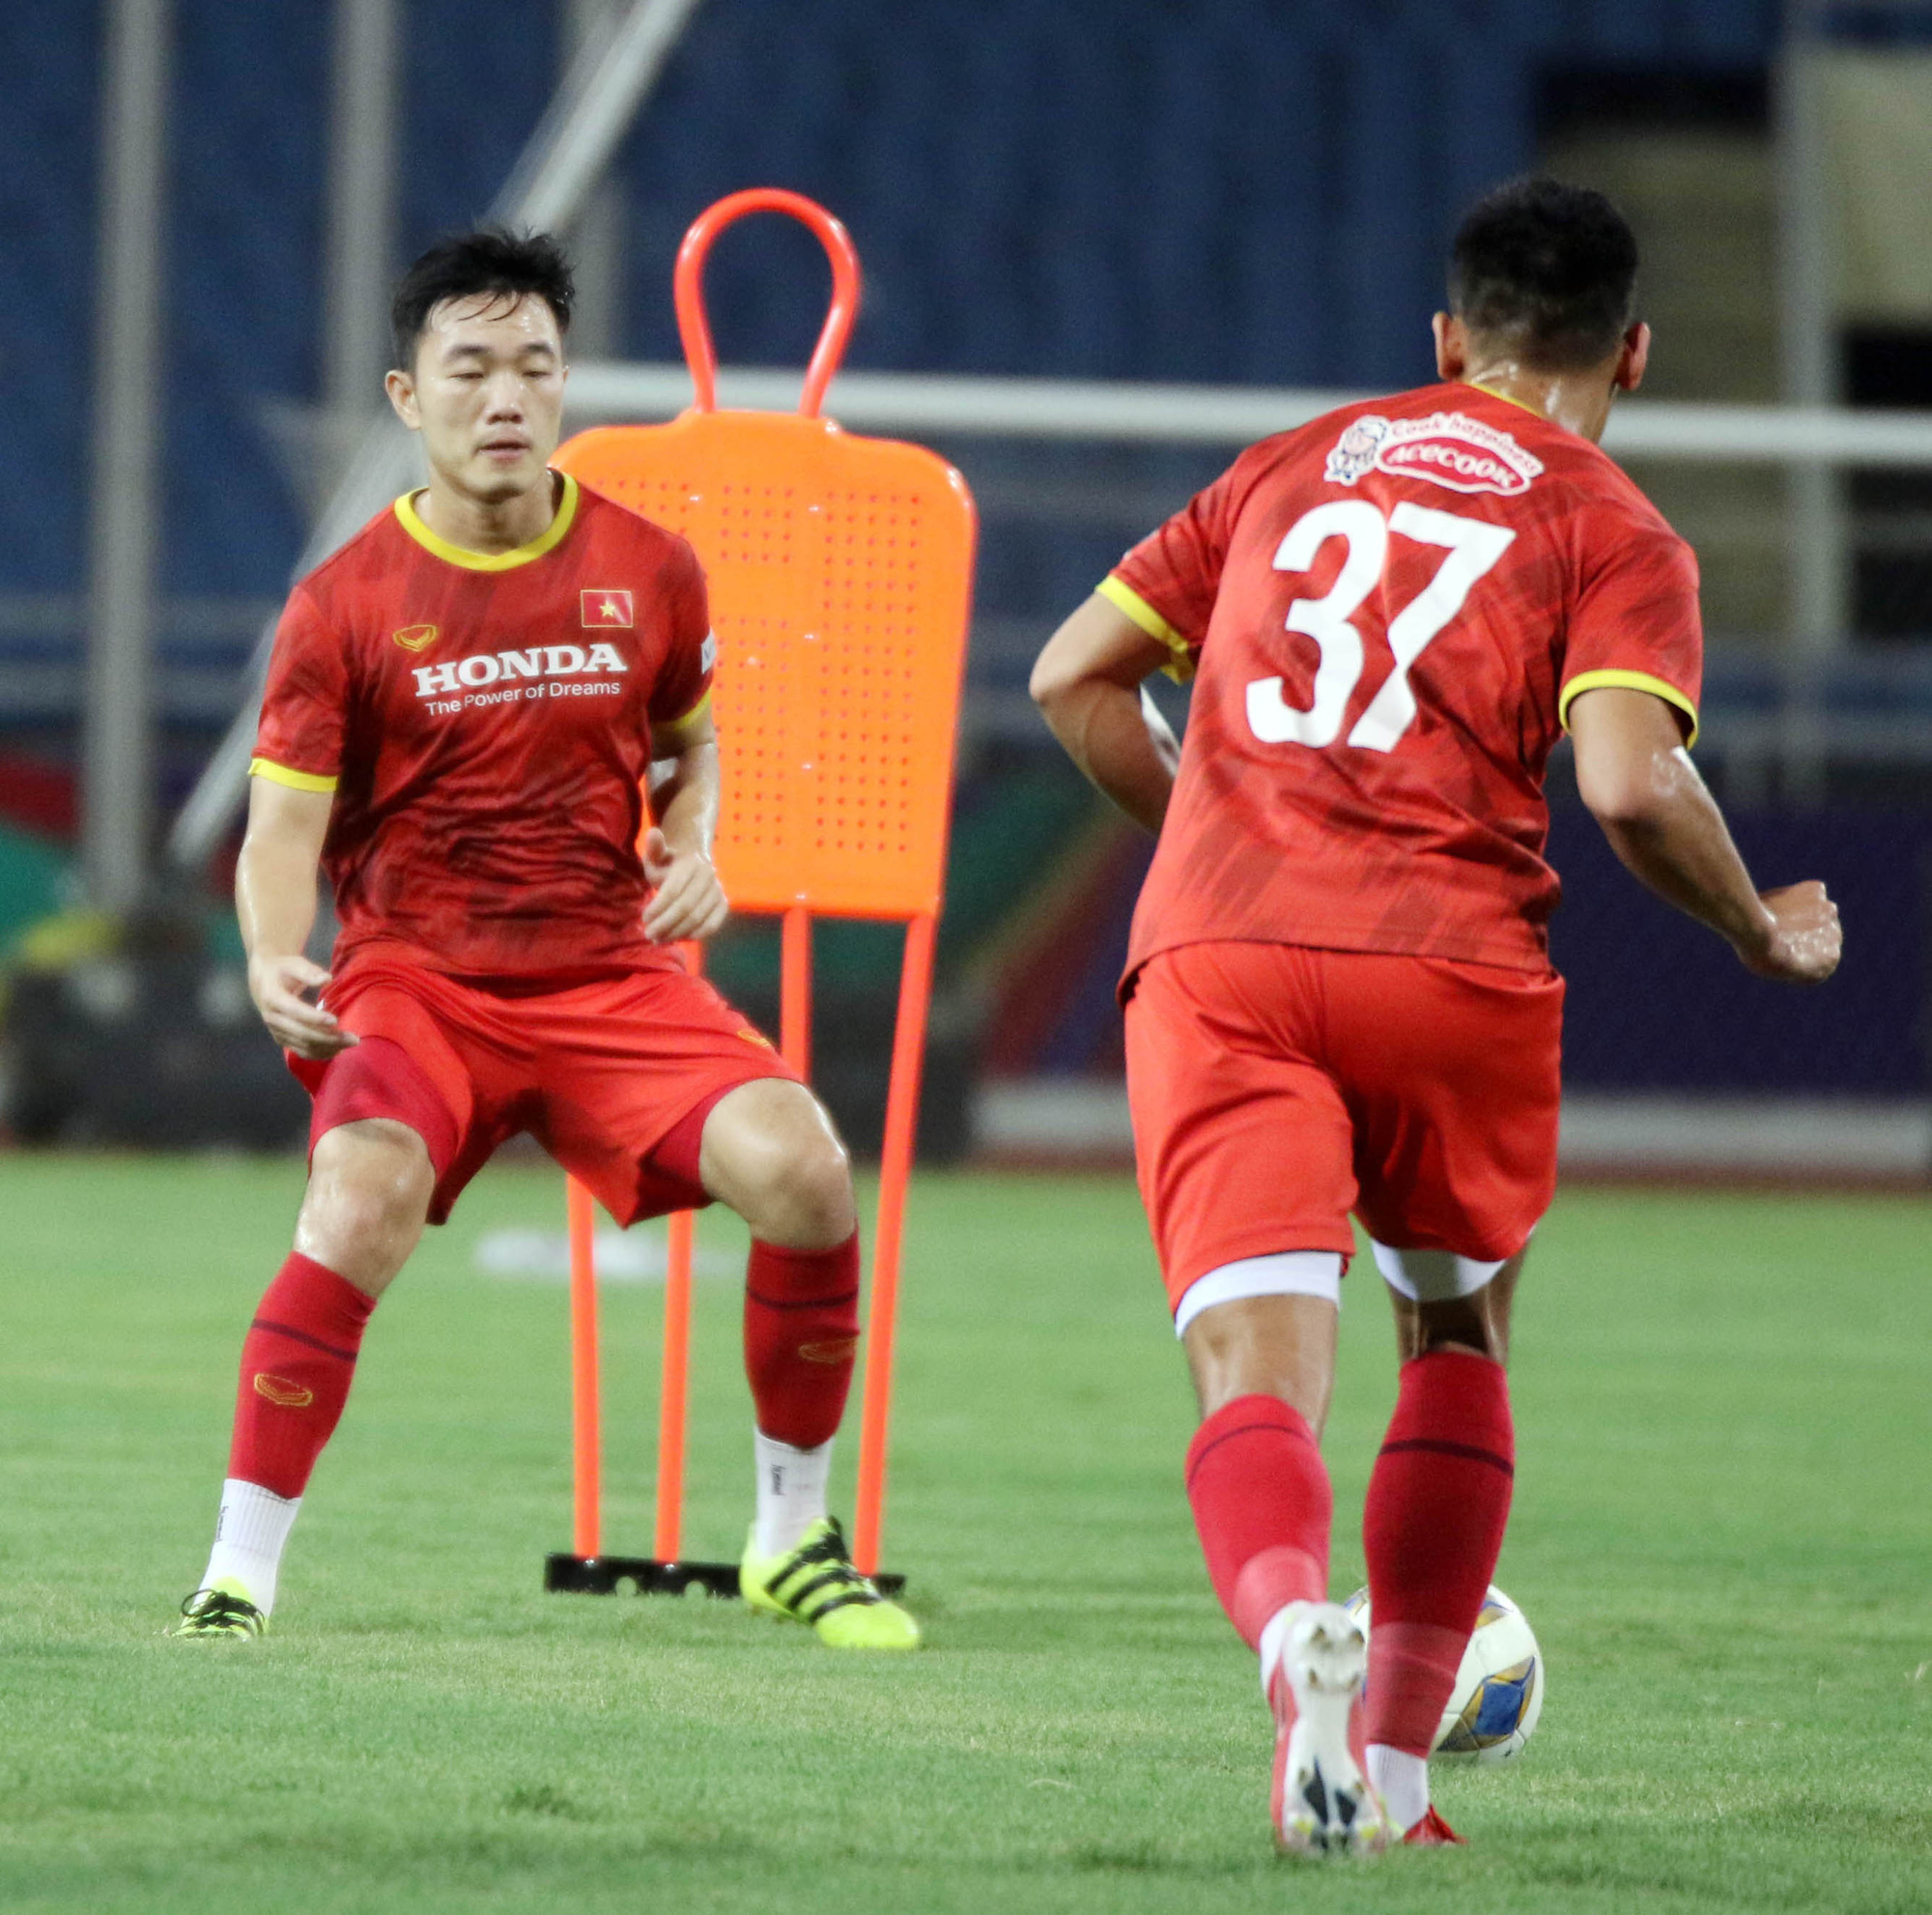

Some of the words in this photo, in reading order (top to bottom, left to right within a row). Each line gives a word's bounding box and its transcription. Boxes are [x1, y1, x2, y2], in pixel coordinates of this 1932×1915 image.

[1246, 500, 1517, 754] 37
[412, 643, 628, 698] HONDA
[425, 699, 462, 717] The
[465, 687, 522, 709] Power
[525, 683, 546, 700] of
[549, 681, 621, 698] Dreams
